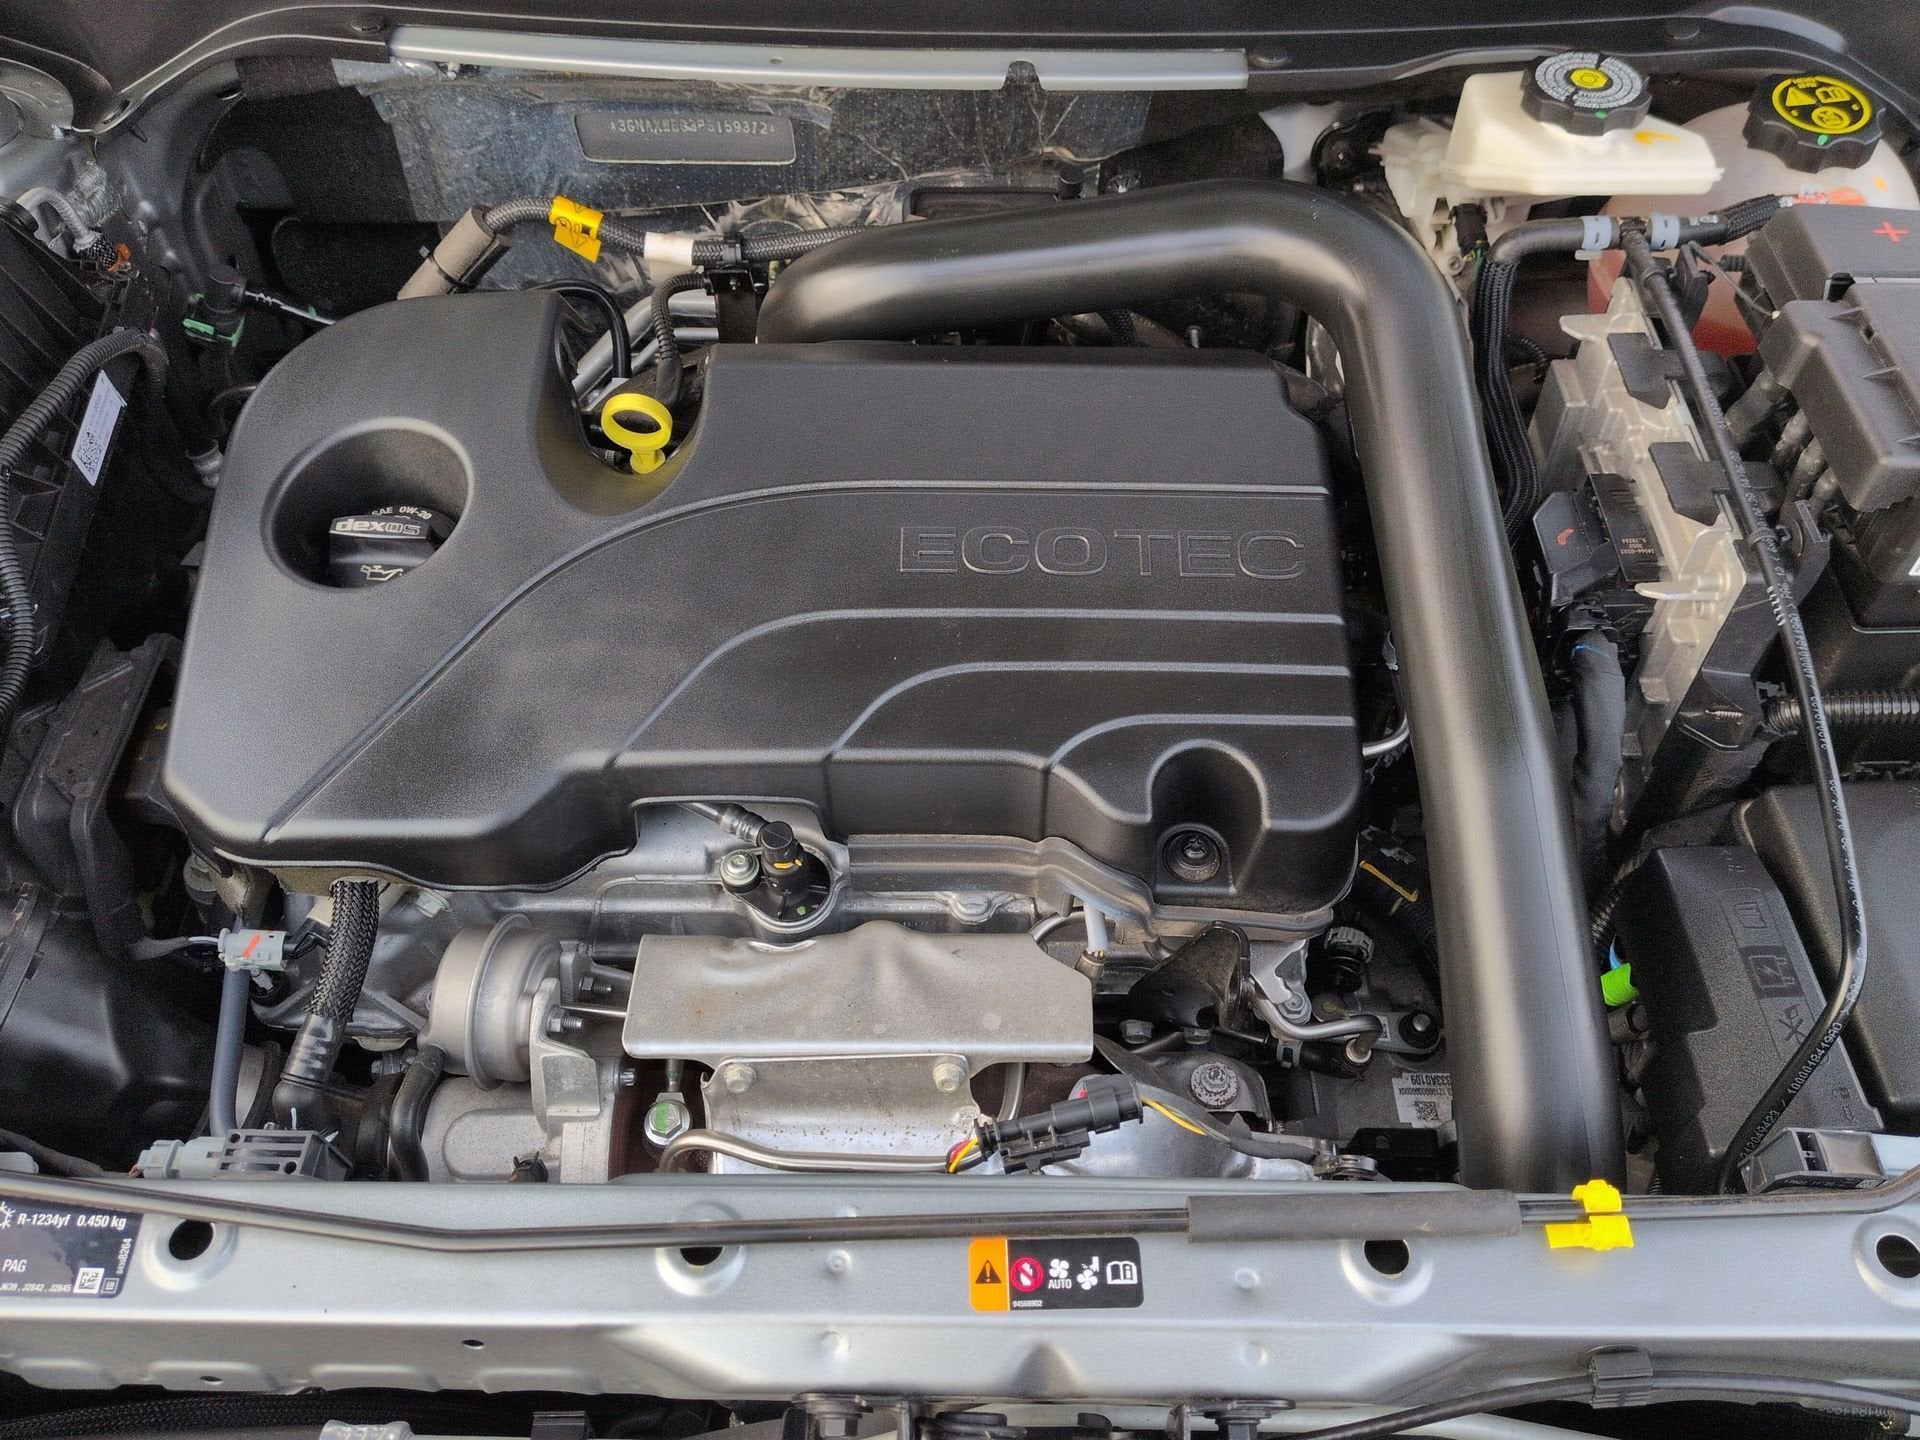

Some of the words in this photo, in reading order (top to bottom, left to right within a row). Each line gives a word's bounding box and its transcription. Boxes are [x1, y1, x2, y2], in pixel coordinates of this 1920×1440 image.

[371, 506, 394, 516] SAE
[399, 505, 433, 520] 0W-20
[335, 518, 422, 536] dexos
[900, 526, 1305, 580] ECOTEC
[17, 1212, 72, 1229] R-1234yf
[76, 1214, 110, 1227] 0.450
[110, 1215, 128, 1230] kg
[2, 1258, 28, 1273] PAG
[1047, 1279, 1072, 1290] AUTO
